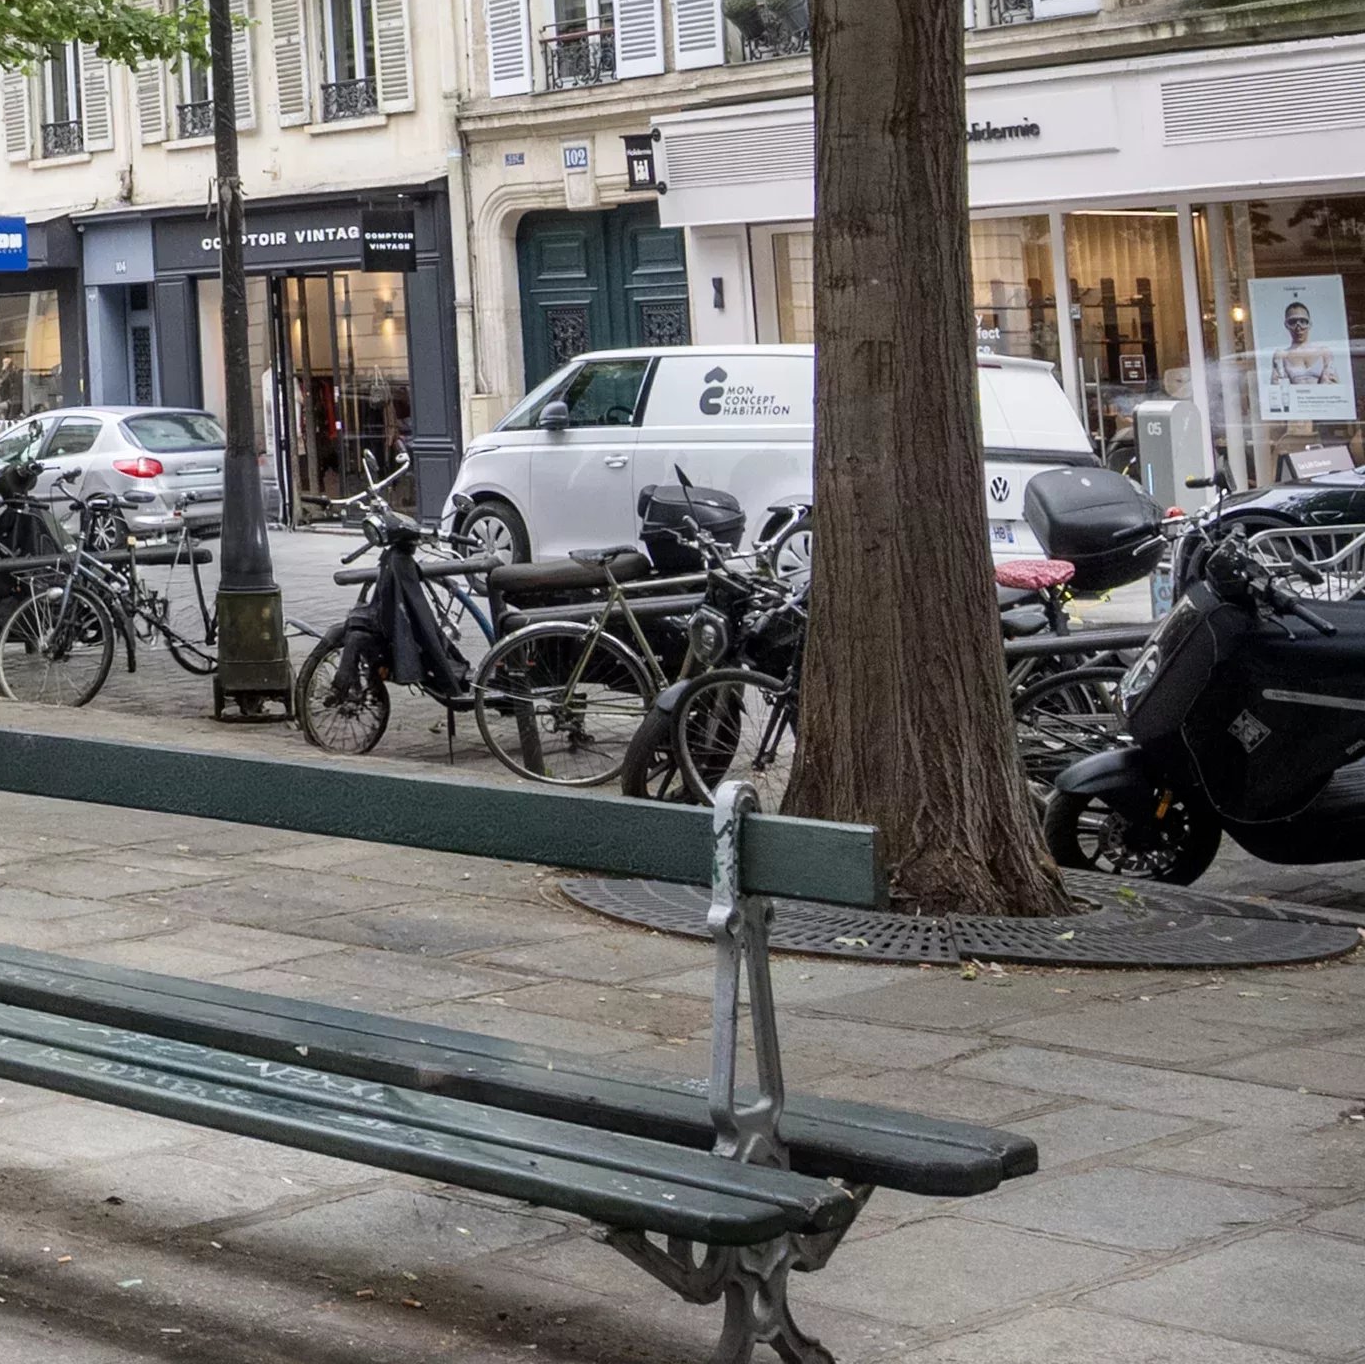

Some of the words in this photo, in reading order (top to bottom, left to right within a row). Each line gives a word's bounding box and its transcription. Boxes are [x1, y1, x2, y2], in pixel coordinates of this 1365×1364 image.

[966, 117, 1040, 141] olidermie
[565, 148, 587, 166] 102
[201, 231, 287, 250] COTOIR
[294, 226, 360, 243] VINTAG
[364, 232, 414, 240] COMPTOIR
[369, 242, 411, 250] VINTAGE
[726, 386, 754, 395] MON
[724, 395, 776, 405] CONCEPT
[1147, 422, 1162, 436] 05
